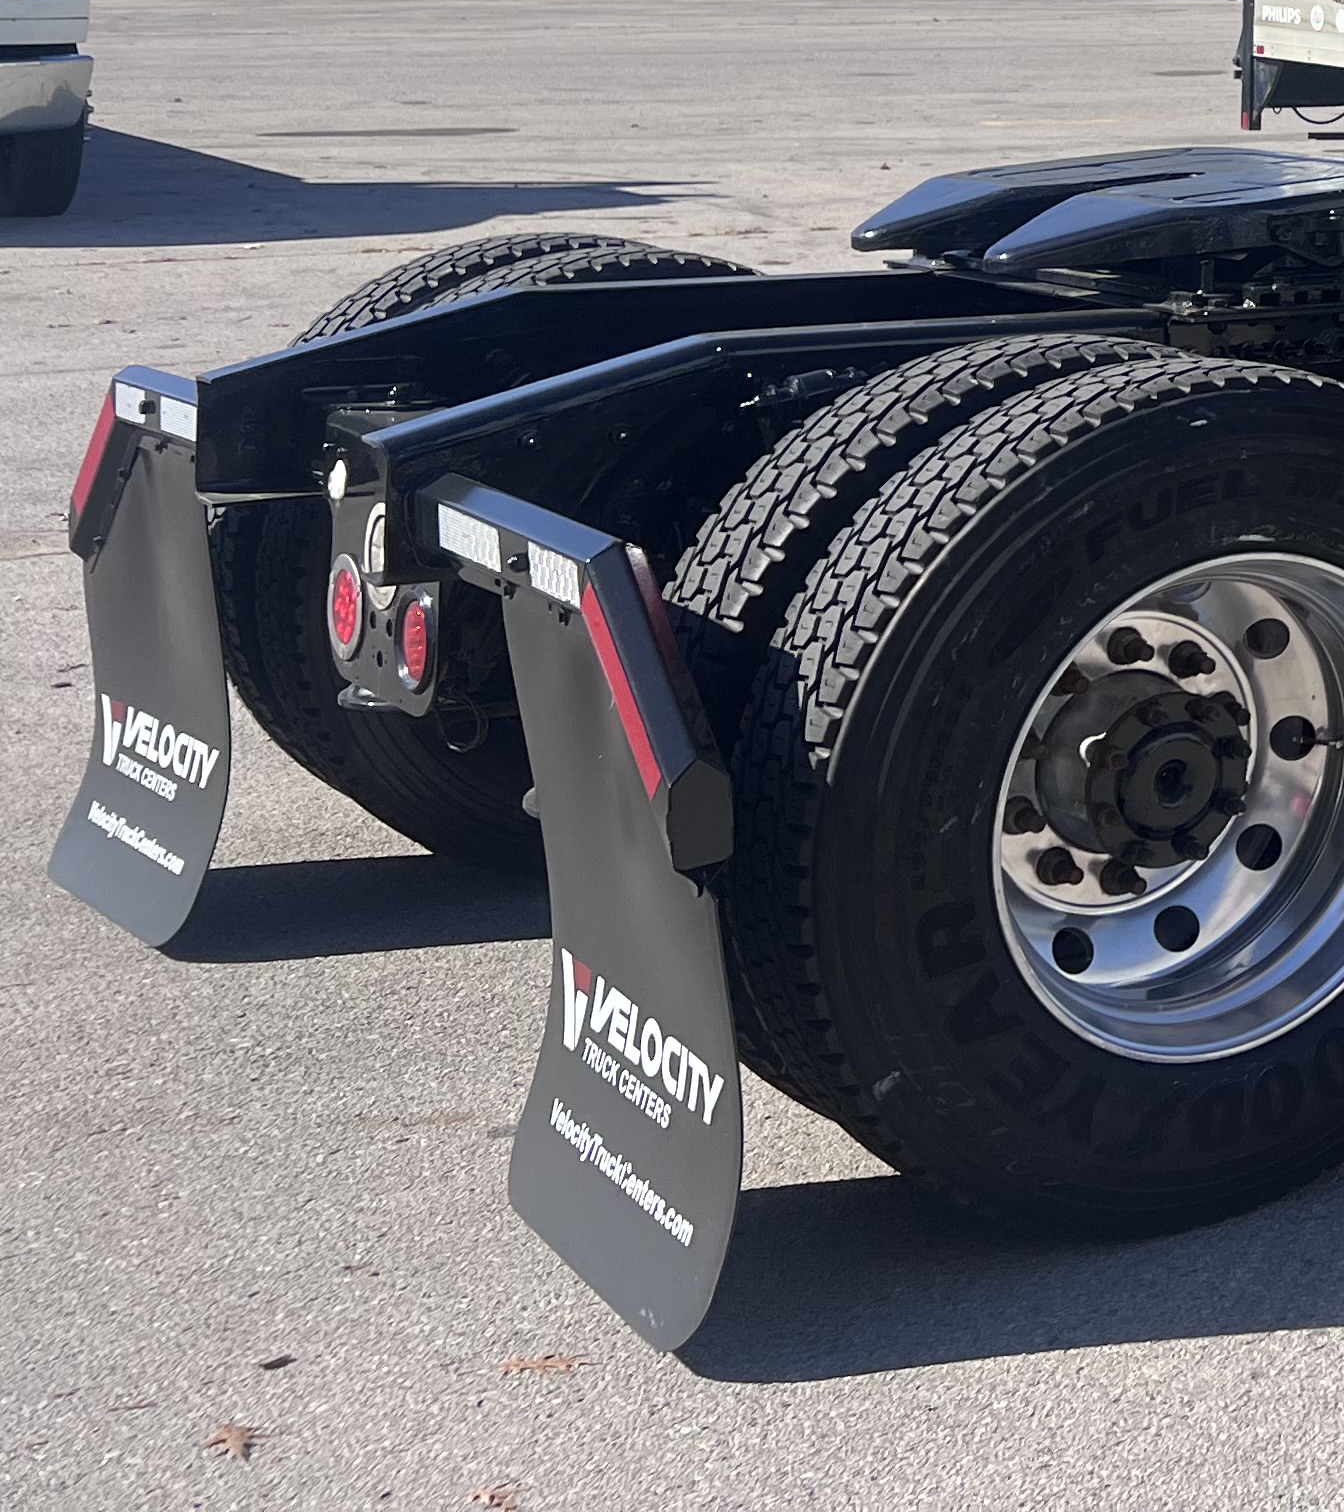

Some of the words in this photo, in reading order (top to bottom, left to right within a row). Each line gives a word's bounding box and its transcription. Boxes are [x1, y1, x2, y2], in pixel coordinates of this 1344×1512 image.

[1262, 5, 1301, 24] PHILIPS
[1084, 469, 1256, 562] FUEL
[115, 753, 140, 782] TRUCK
[141, 767, 177, 802] CENTERS
[122, 706, 219, 789] VELOCITY
[581, 1038, 618, 1087] TRUCK
[618, 1069, 671, 1129] CENTERS
[589, 975, 725, 1126] VELOCITY
[549, 1097, 694, 1247] VelocityTruckCenters.com
